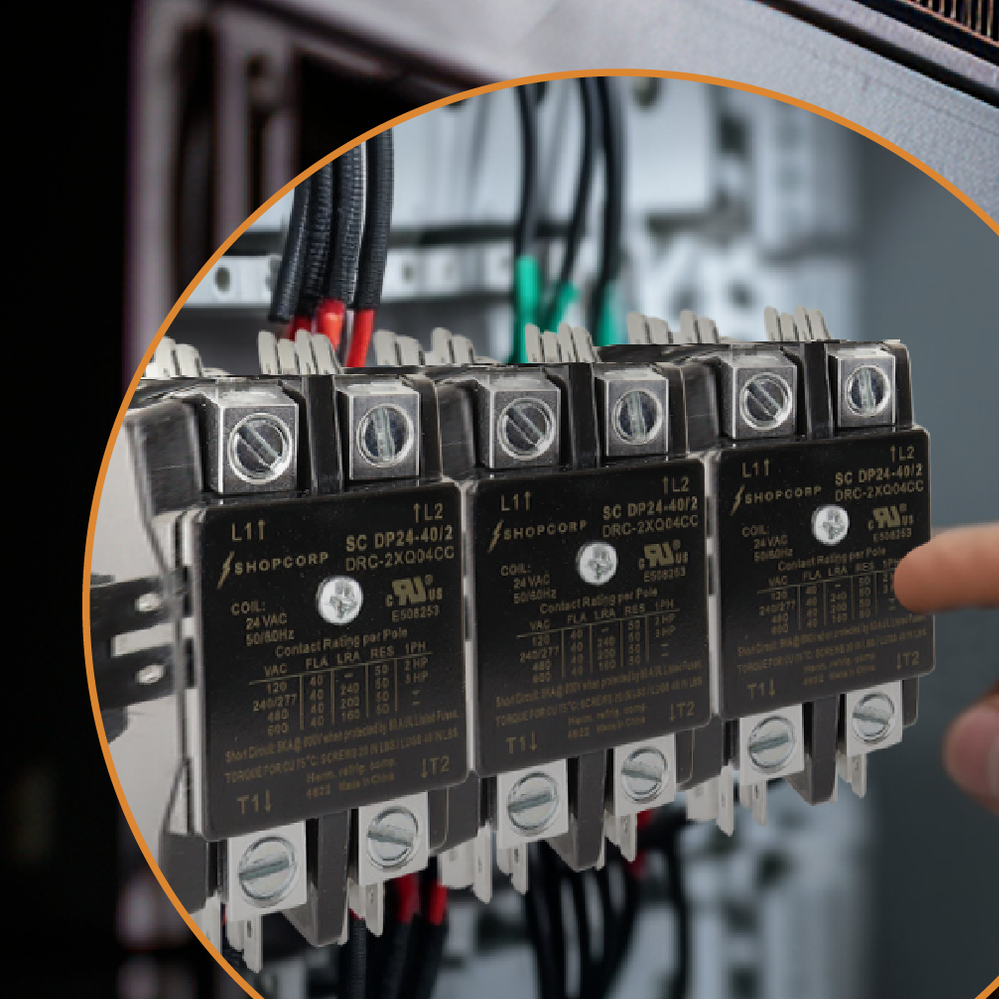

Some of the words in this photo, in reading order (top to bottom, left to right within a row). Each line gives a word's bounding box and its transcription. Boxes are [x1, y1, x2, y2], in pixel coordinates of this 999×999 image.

[899, 445, 915, 461] L2
[742, 462, 759, 478] L1
[835, 472, 853, 487] SC
[858, 463, 924, 483] DP24-40/2
[672, 476, 690, 493] L2
[501, 493, 519, 512] L1
[745, 485, 822, 504] SHOPCORP
[424, 503, 443, 521] L2
[603, 504, 622, 521] SC
[627, 496, 698, 517] DP24-40/2
[231, 522, 252, 541] L1
[346, 534, 367, 552] SC
[374, 525, 453, 549] DP24-40/2
[503, 520, 588, 541] SHOPCORP
[234, 551, 329, 575] SHOPCORP
[540, 598, 581, 614] Contact
[263, 613, 288, 627] VAC
[275, 639, 321, 658] Contact
[323, 634, 360, 650] Rating
[263, 663, 288, 677] VAC
[305, 656, 329, 670] FLA
[337, 650, 360, 664] LRA
[902, 650, 920, 666] T2
[747, 682, 765, 700] T1
[676, 701, 695, 718] T2
[506, 735, 526, 754] T1
[429, 755, 450, 776] T2
[236, 793, 259, 815] T1
